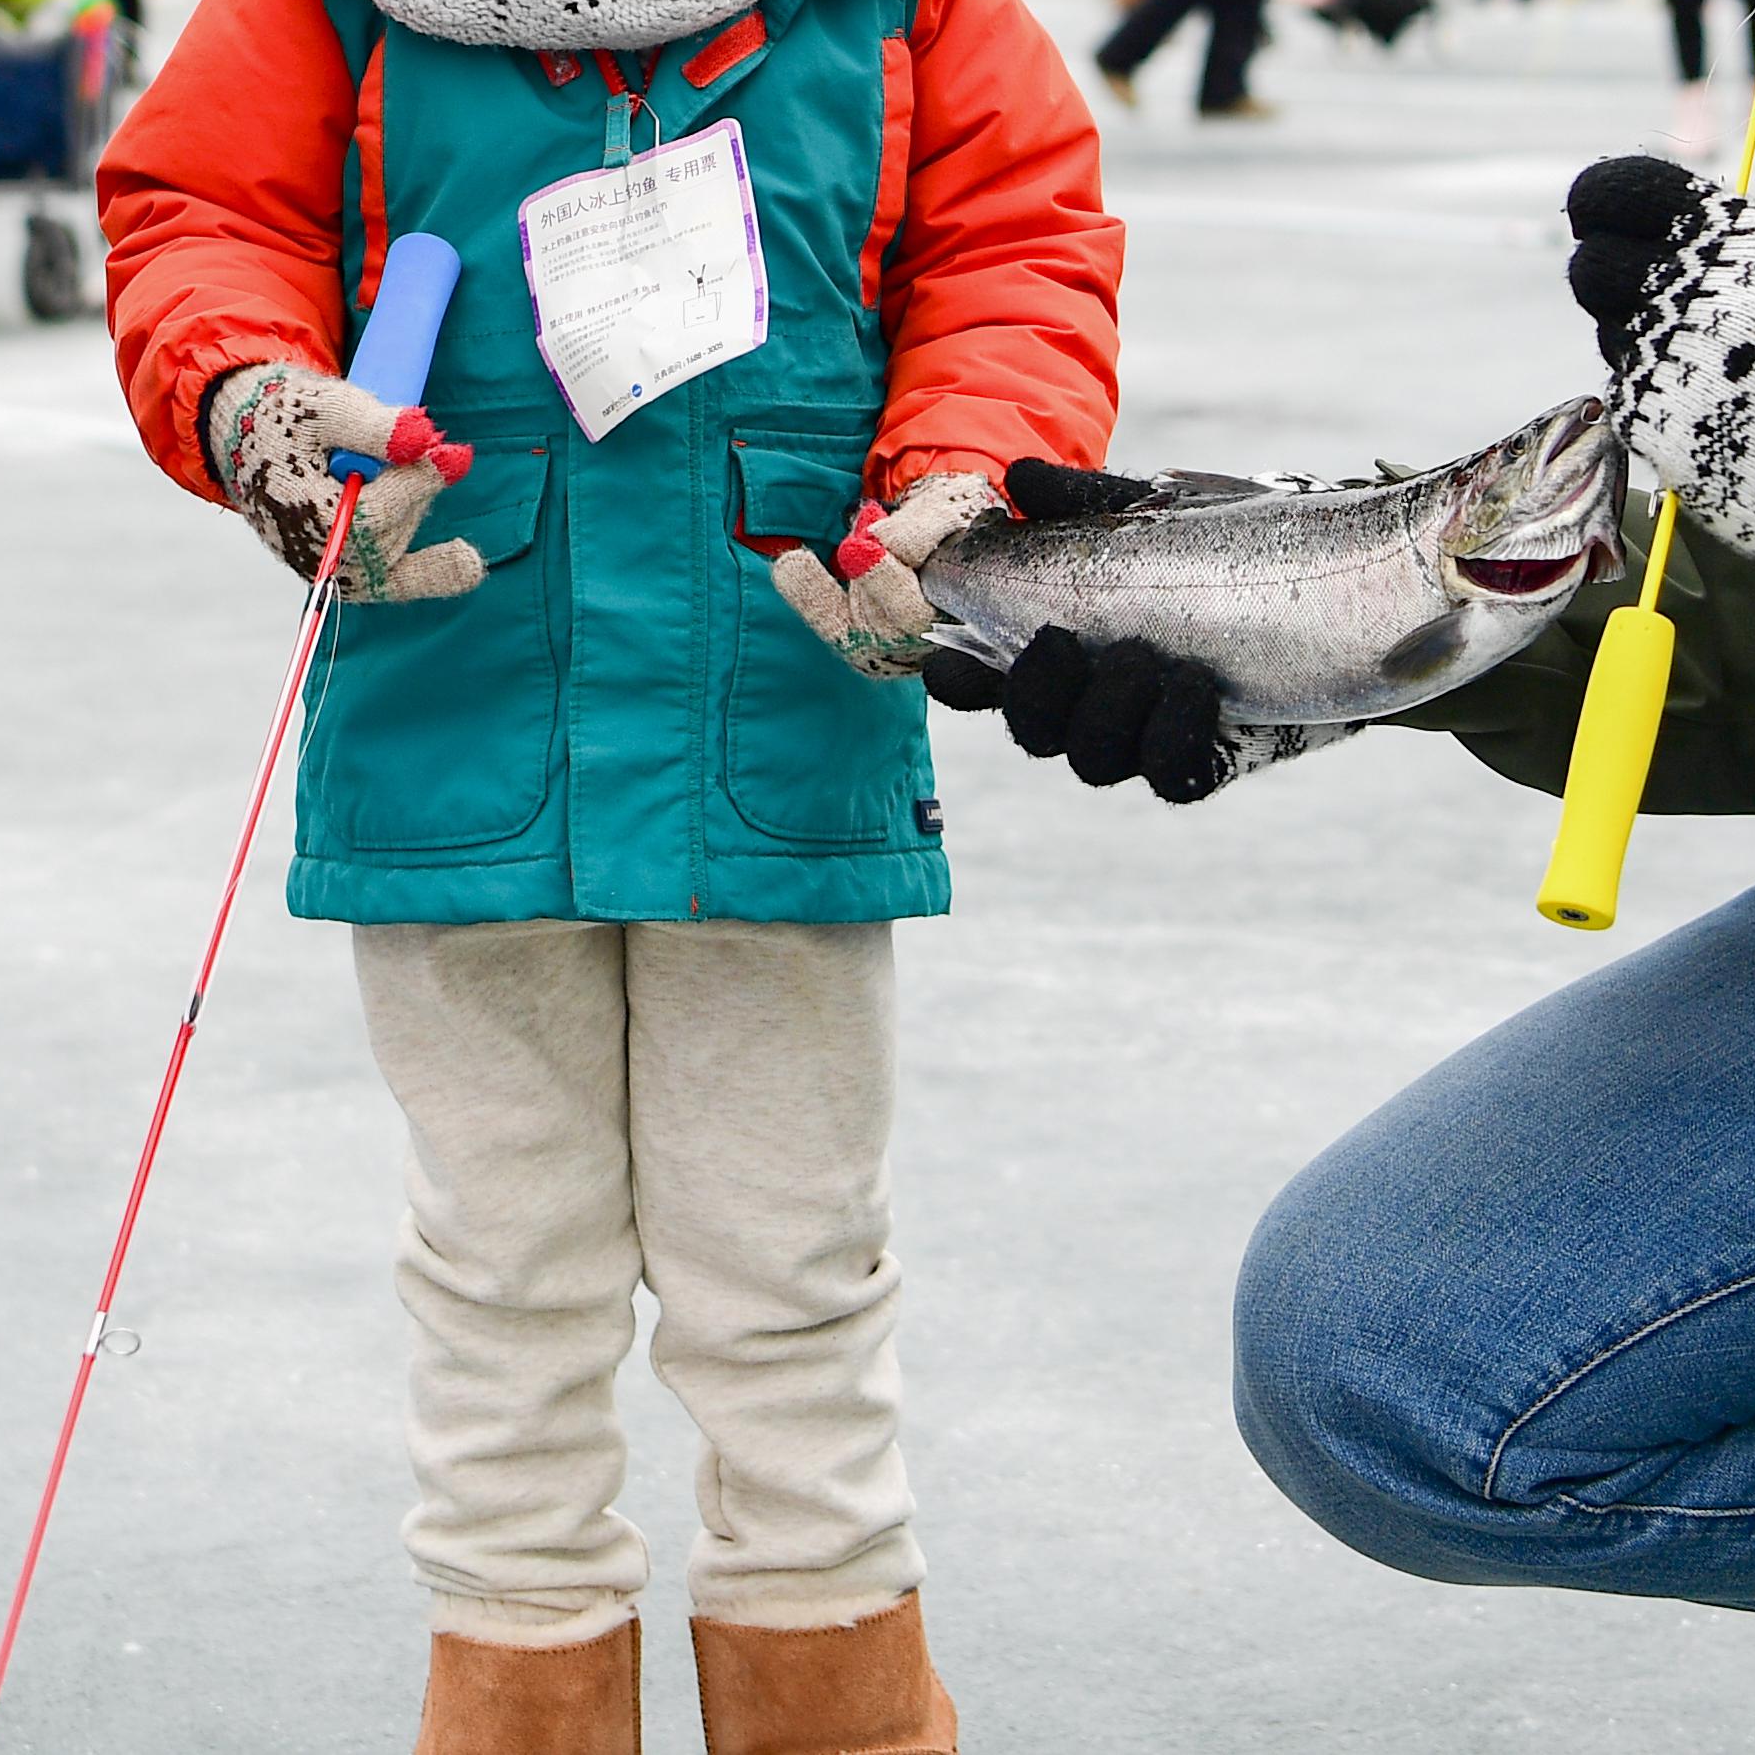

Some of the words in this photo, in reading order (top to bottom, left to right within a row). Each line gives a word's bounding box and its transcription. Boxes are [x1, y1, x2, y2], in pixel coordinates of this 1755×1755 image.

[540, 176, 658, 230] 外国人冰上钓鱼
[665, 151, 717, 183] 专用票
